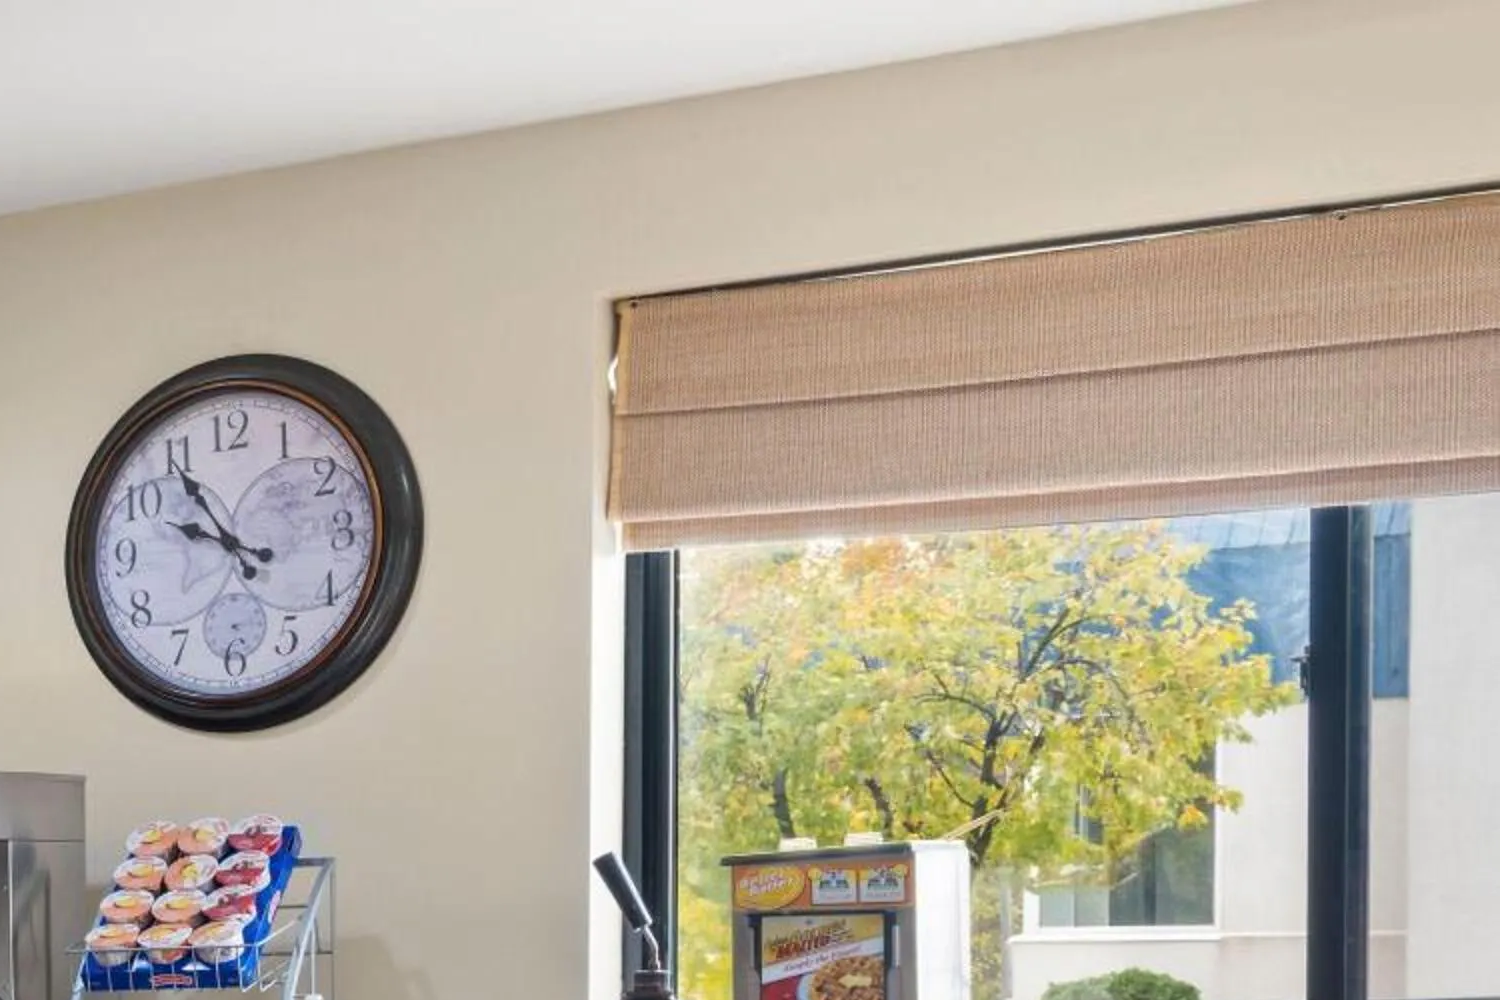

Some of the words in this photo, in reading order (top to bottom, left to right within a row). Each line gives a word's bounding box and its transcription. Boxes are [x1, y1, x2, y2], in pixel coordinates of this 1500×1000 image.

[213, 409, 249, 452] 12
[277, 421, 290, 460] 1
[165, 435, 194, 475] 11
[313, 456, 337, 497] 2
[124, 481, 162, 521] 10
[332, 509, 355, 550] 3
[115, 538, 137, 577] 9
[314, 569, 339, 606] 4
[130, 590, 152, 628] 8
[170, 629, 190, 666] 7
[275, 615, 299, 656] 5
[224, 638, 247, 677] 6
